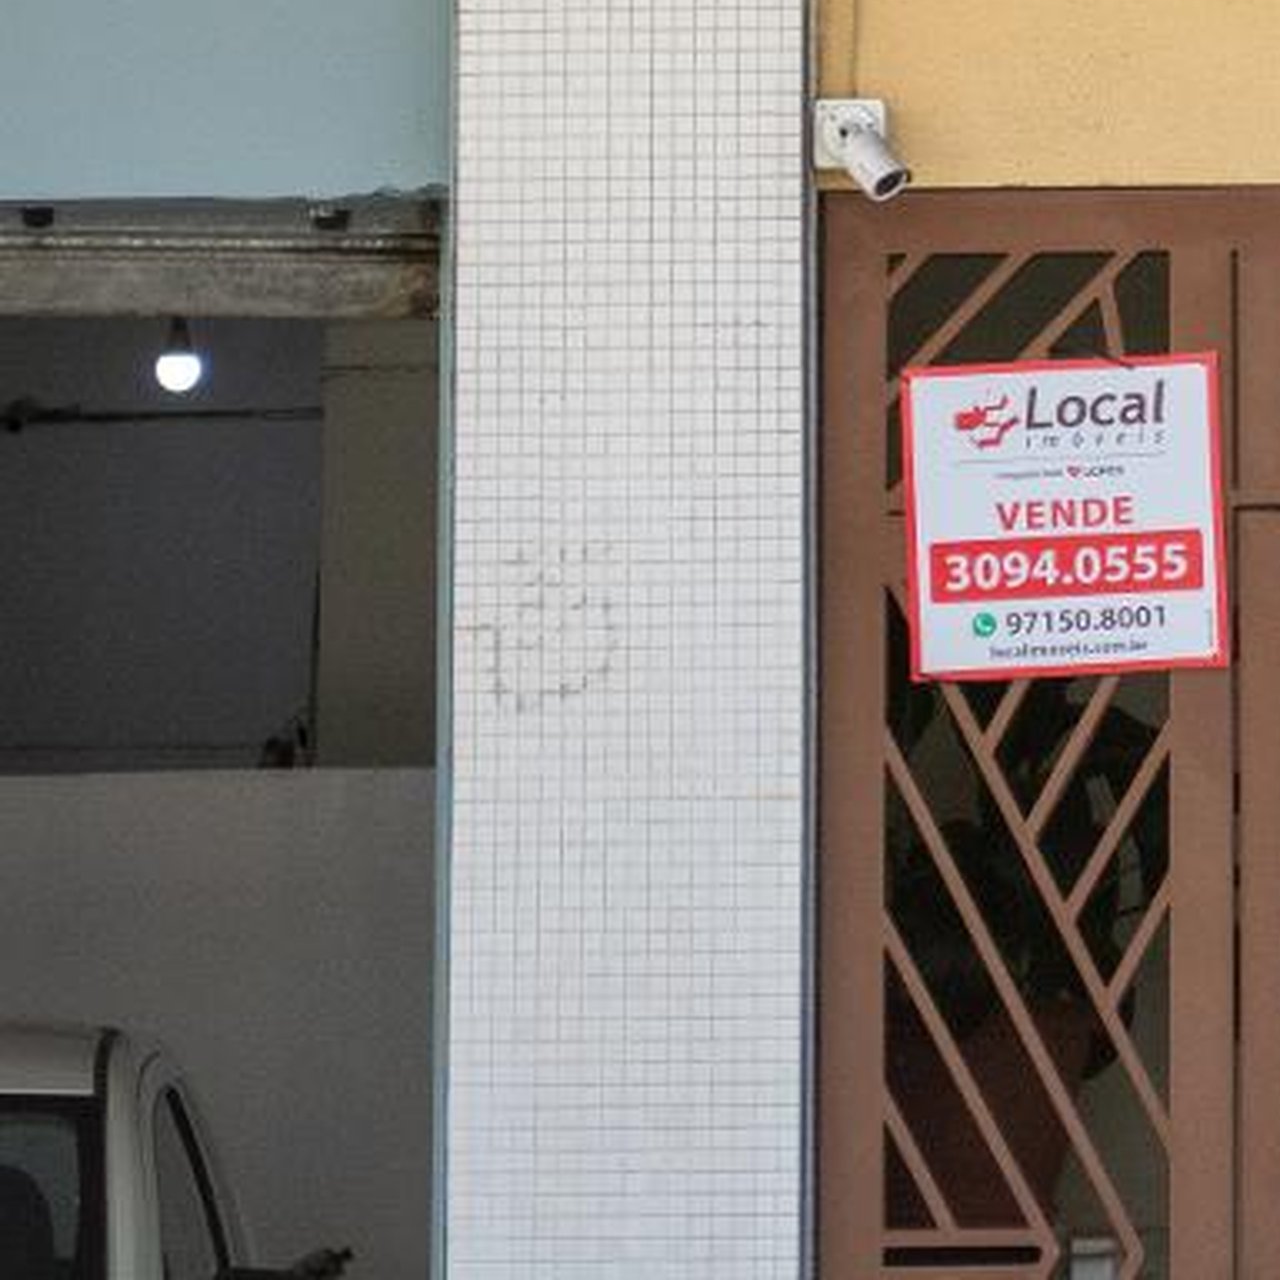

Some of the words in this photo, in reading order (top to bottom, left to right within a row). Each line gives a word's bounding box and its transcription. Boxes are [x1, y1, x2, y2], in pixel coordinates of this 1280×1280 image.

[1025, 379, 1165, 430] Local
[994, 495, 1134, 532] VENDE
[945, 542, 1189, 591] 3094.0555
[1006, 604, 1166, 637] 97150.8001
